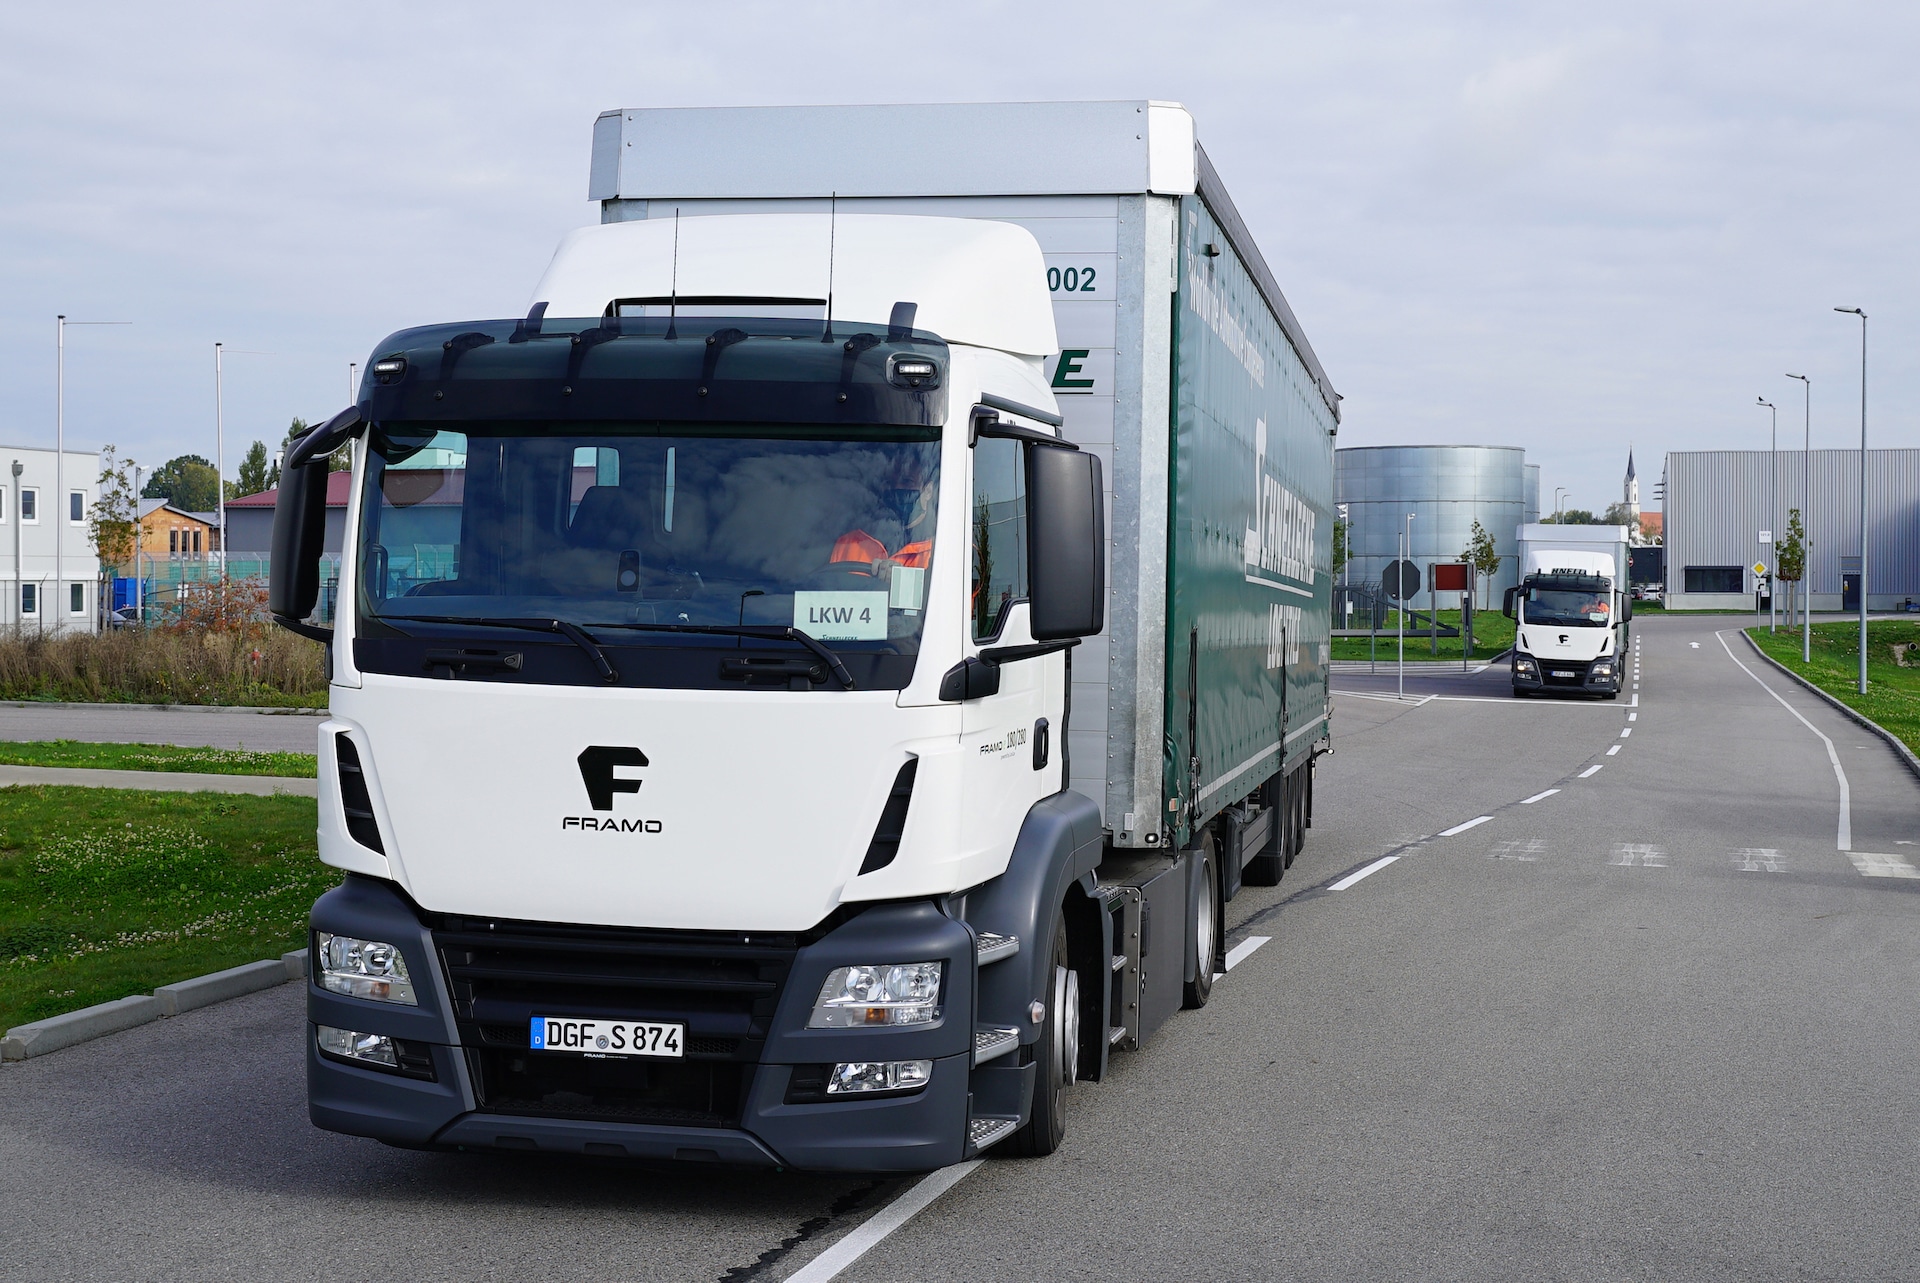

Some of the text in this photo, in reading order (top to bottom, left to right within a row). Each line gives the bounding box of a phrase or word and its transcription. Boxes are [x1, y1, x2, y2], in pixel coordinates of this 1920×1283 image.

[1047, 267, 1096, 292] 002
[809, 607, 871, 623] LKW 4
[980, 741, 1003, 756] FRAMO
[562, 816, 662, 833] FRAMO
[547, 1021, 678, 1053] DGF S 874
